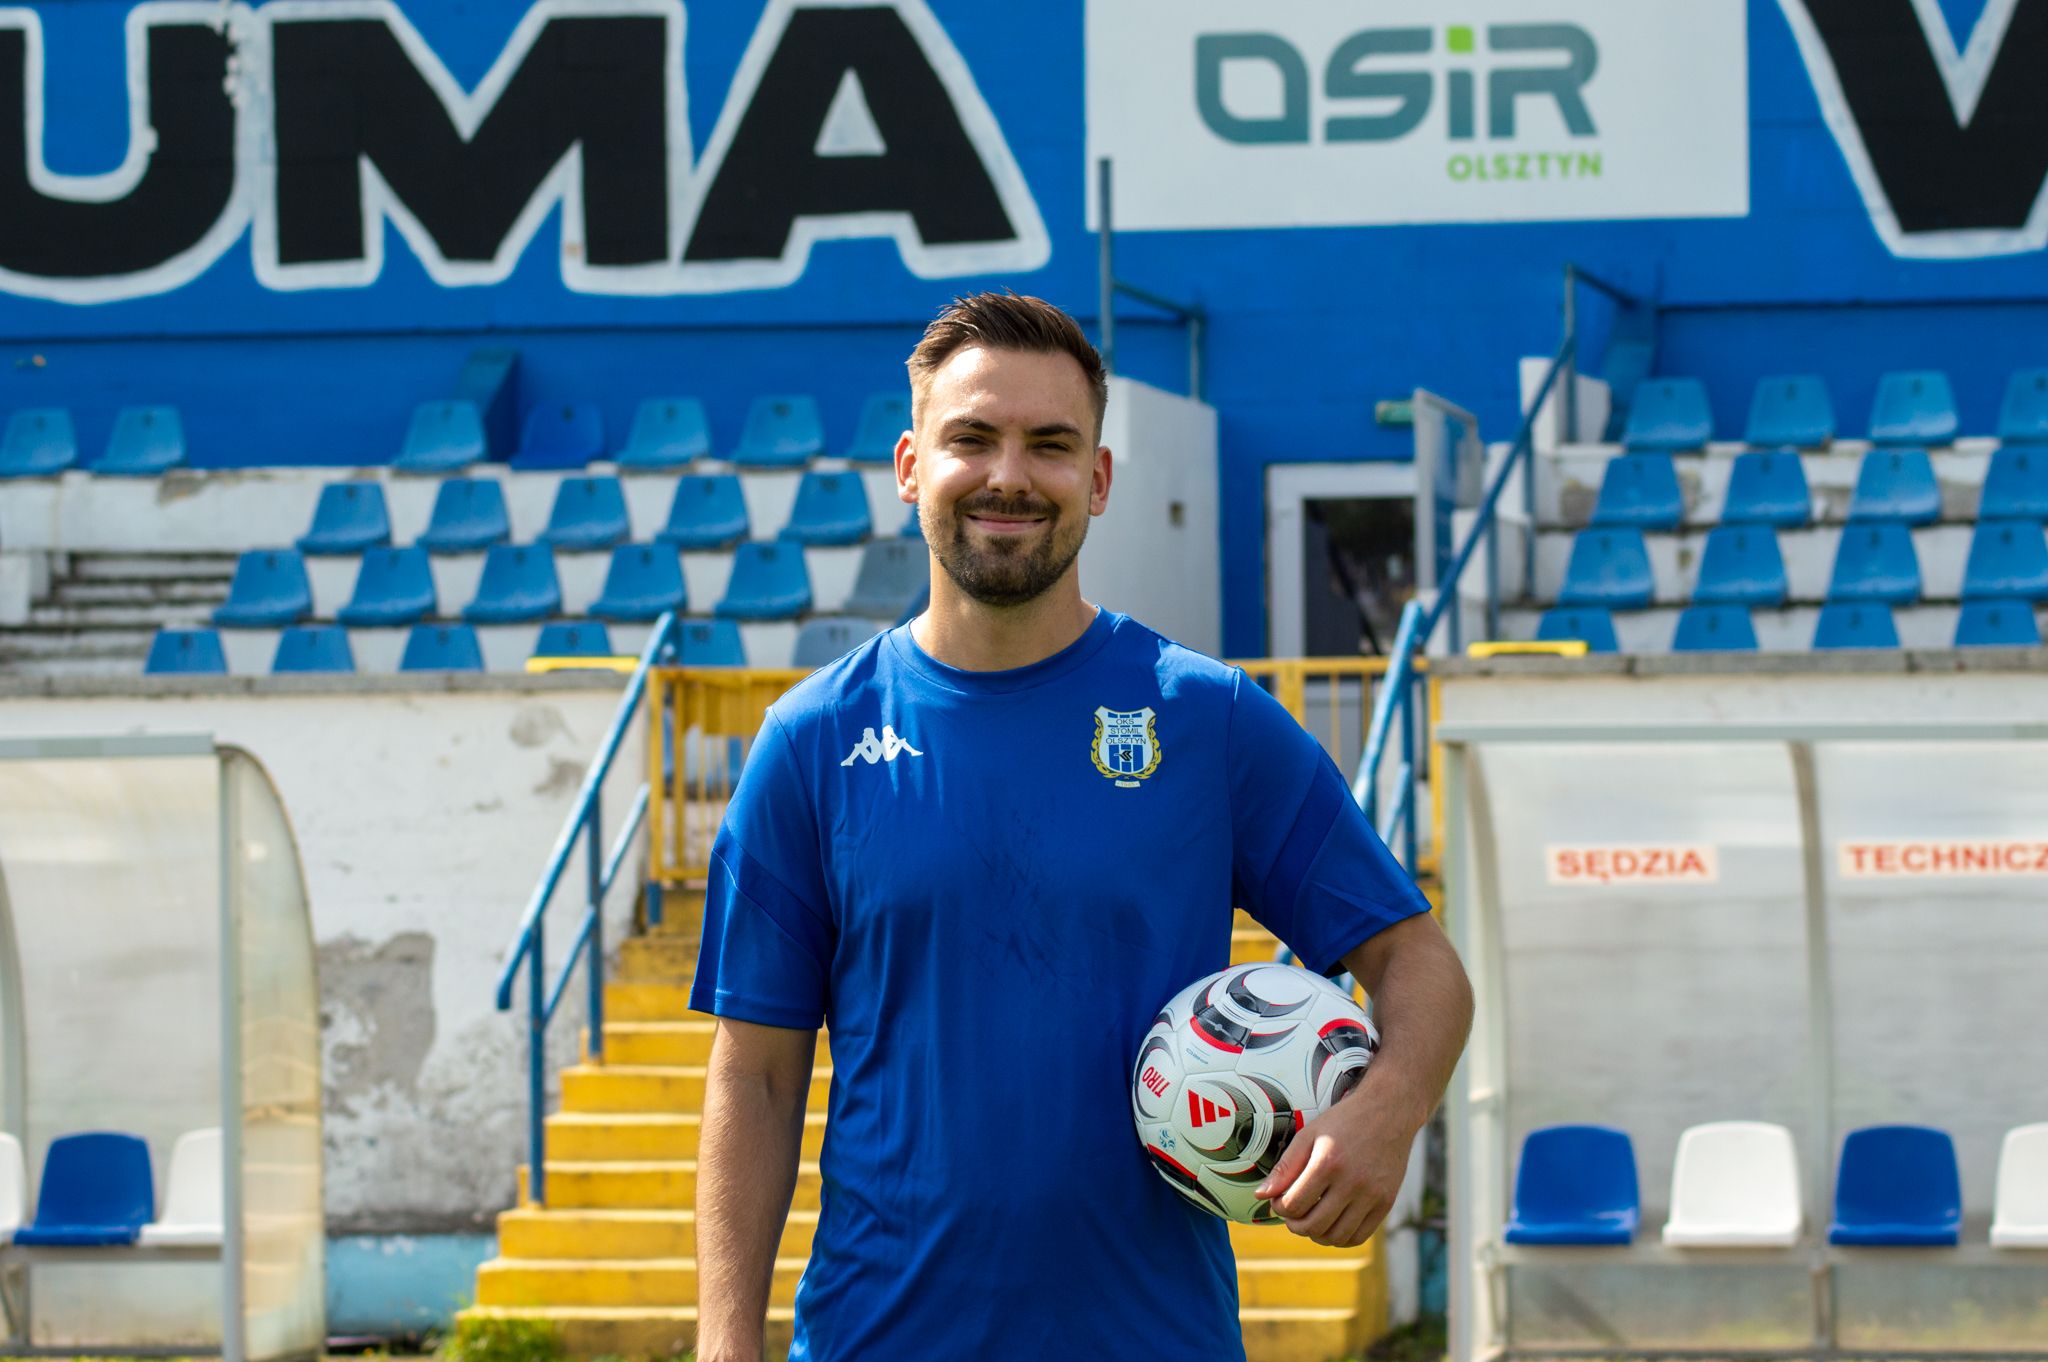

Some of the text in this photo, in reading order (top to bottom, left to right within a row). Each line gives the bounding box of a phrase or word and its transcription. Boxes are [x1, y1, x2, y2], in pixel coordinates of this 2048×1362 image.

[1446, 153, 1603, 182] OLSZTYN
[1105, 737, 1147, 745] OLSZTYN
[1556, 849, 1708, 883] SĘDZIA
[1142, 1066, 1170, 1098] TIRO
